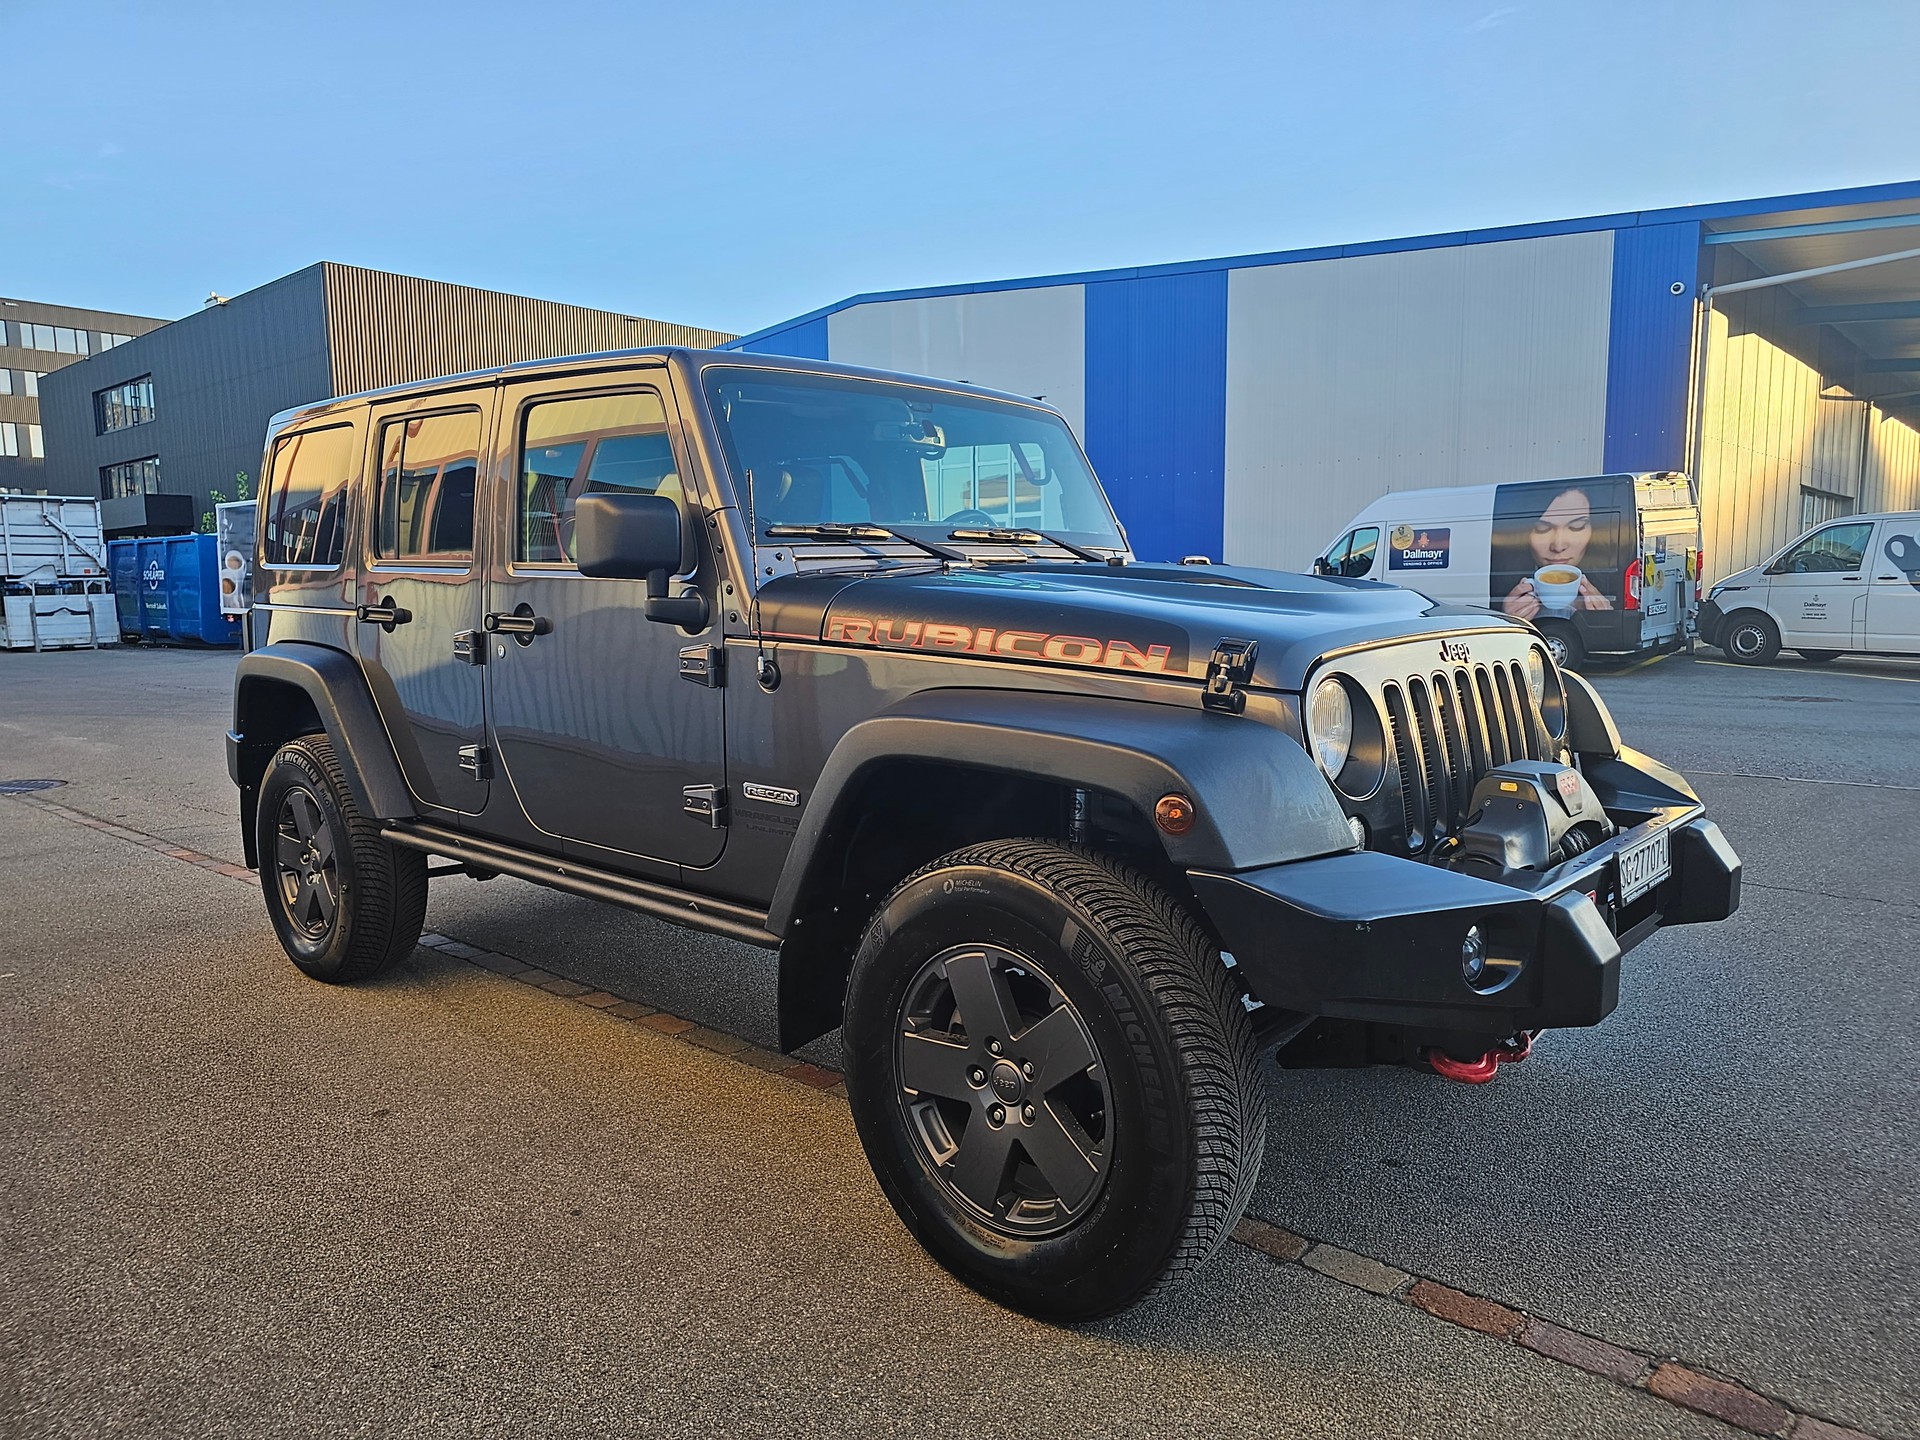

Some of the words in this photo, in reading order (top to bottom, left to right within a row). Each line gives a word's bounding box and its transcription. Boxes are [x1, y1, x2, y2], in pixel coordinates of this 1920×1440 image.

[1403, 549, 1444, 560] Dallmayr
[826, 616, 1173, 674] RUBICON
[1439, 640, 1471, 664] Jeep
[283, 751, 320, 784] MICHELIN
[746, 786, 795, 802] RECON
[955, 880, 983, 888] MICHELIN
[1102, 983, 1171, 1147] MICHELIN
